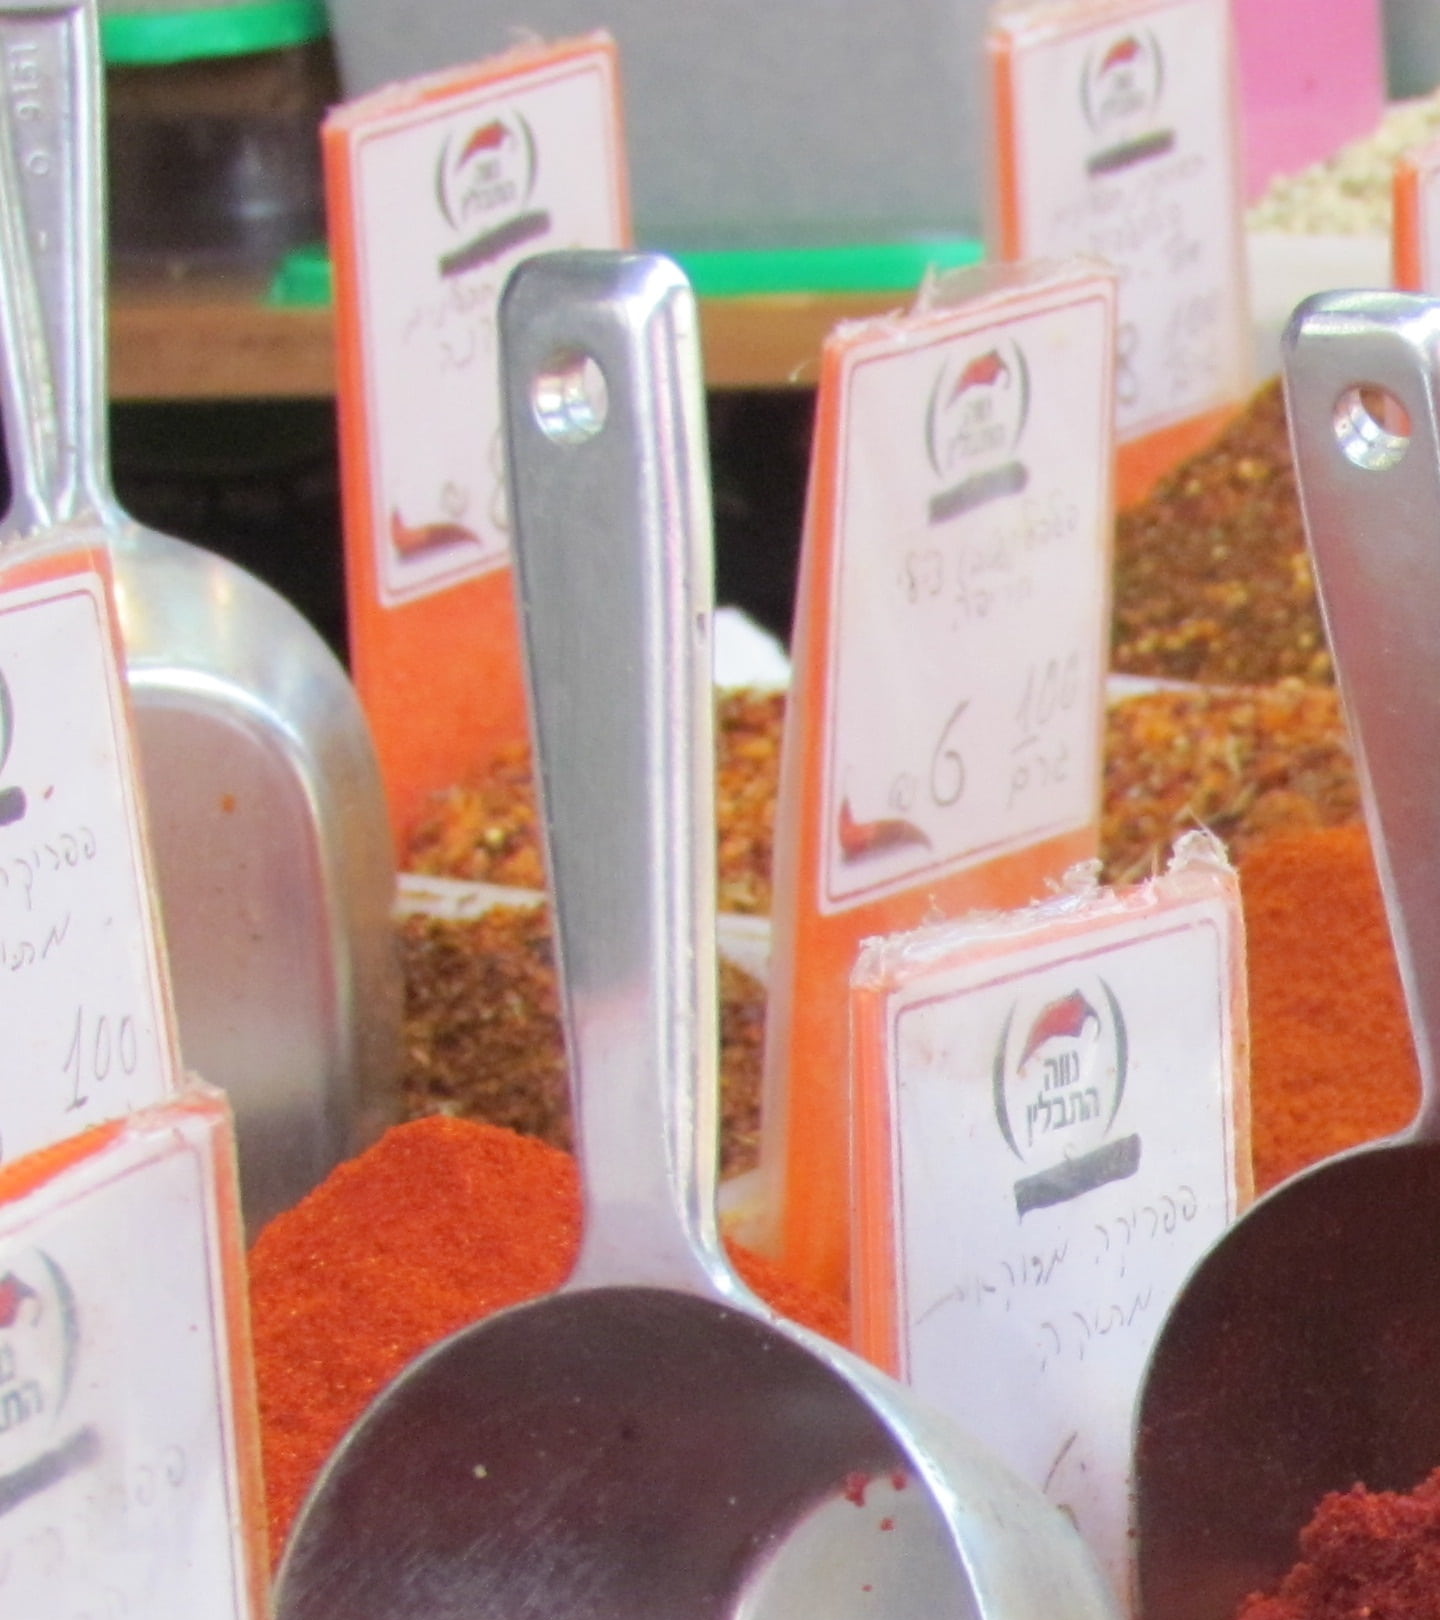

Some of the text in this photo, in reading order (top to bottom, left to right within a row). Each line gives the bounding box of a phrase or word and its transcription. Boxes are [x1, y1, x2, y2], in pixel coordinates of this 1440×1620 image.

[929, 697, 971, 809] 6
[62, 1003, 138, 1114] 100
[1043, 1050, 1080, 1092] נווה
[1026, 1086, 1101, 1149] התבלין
